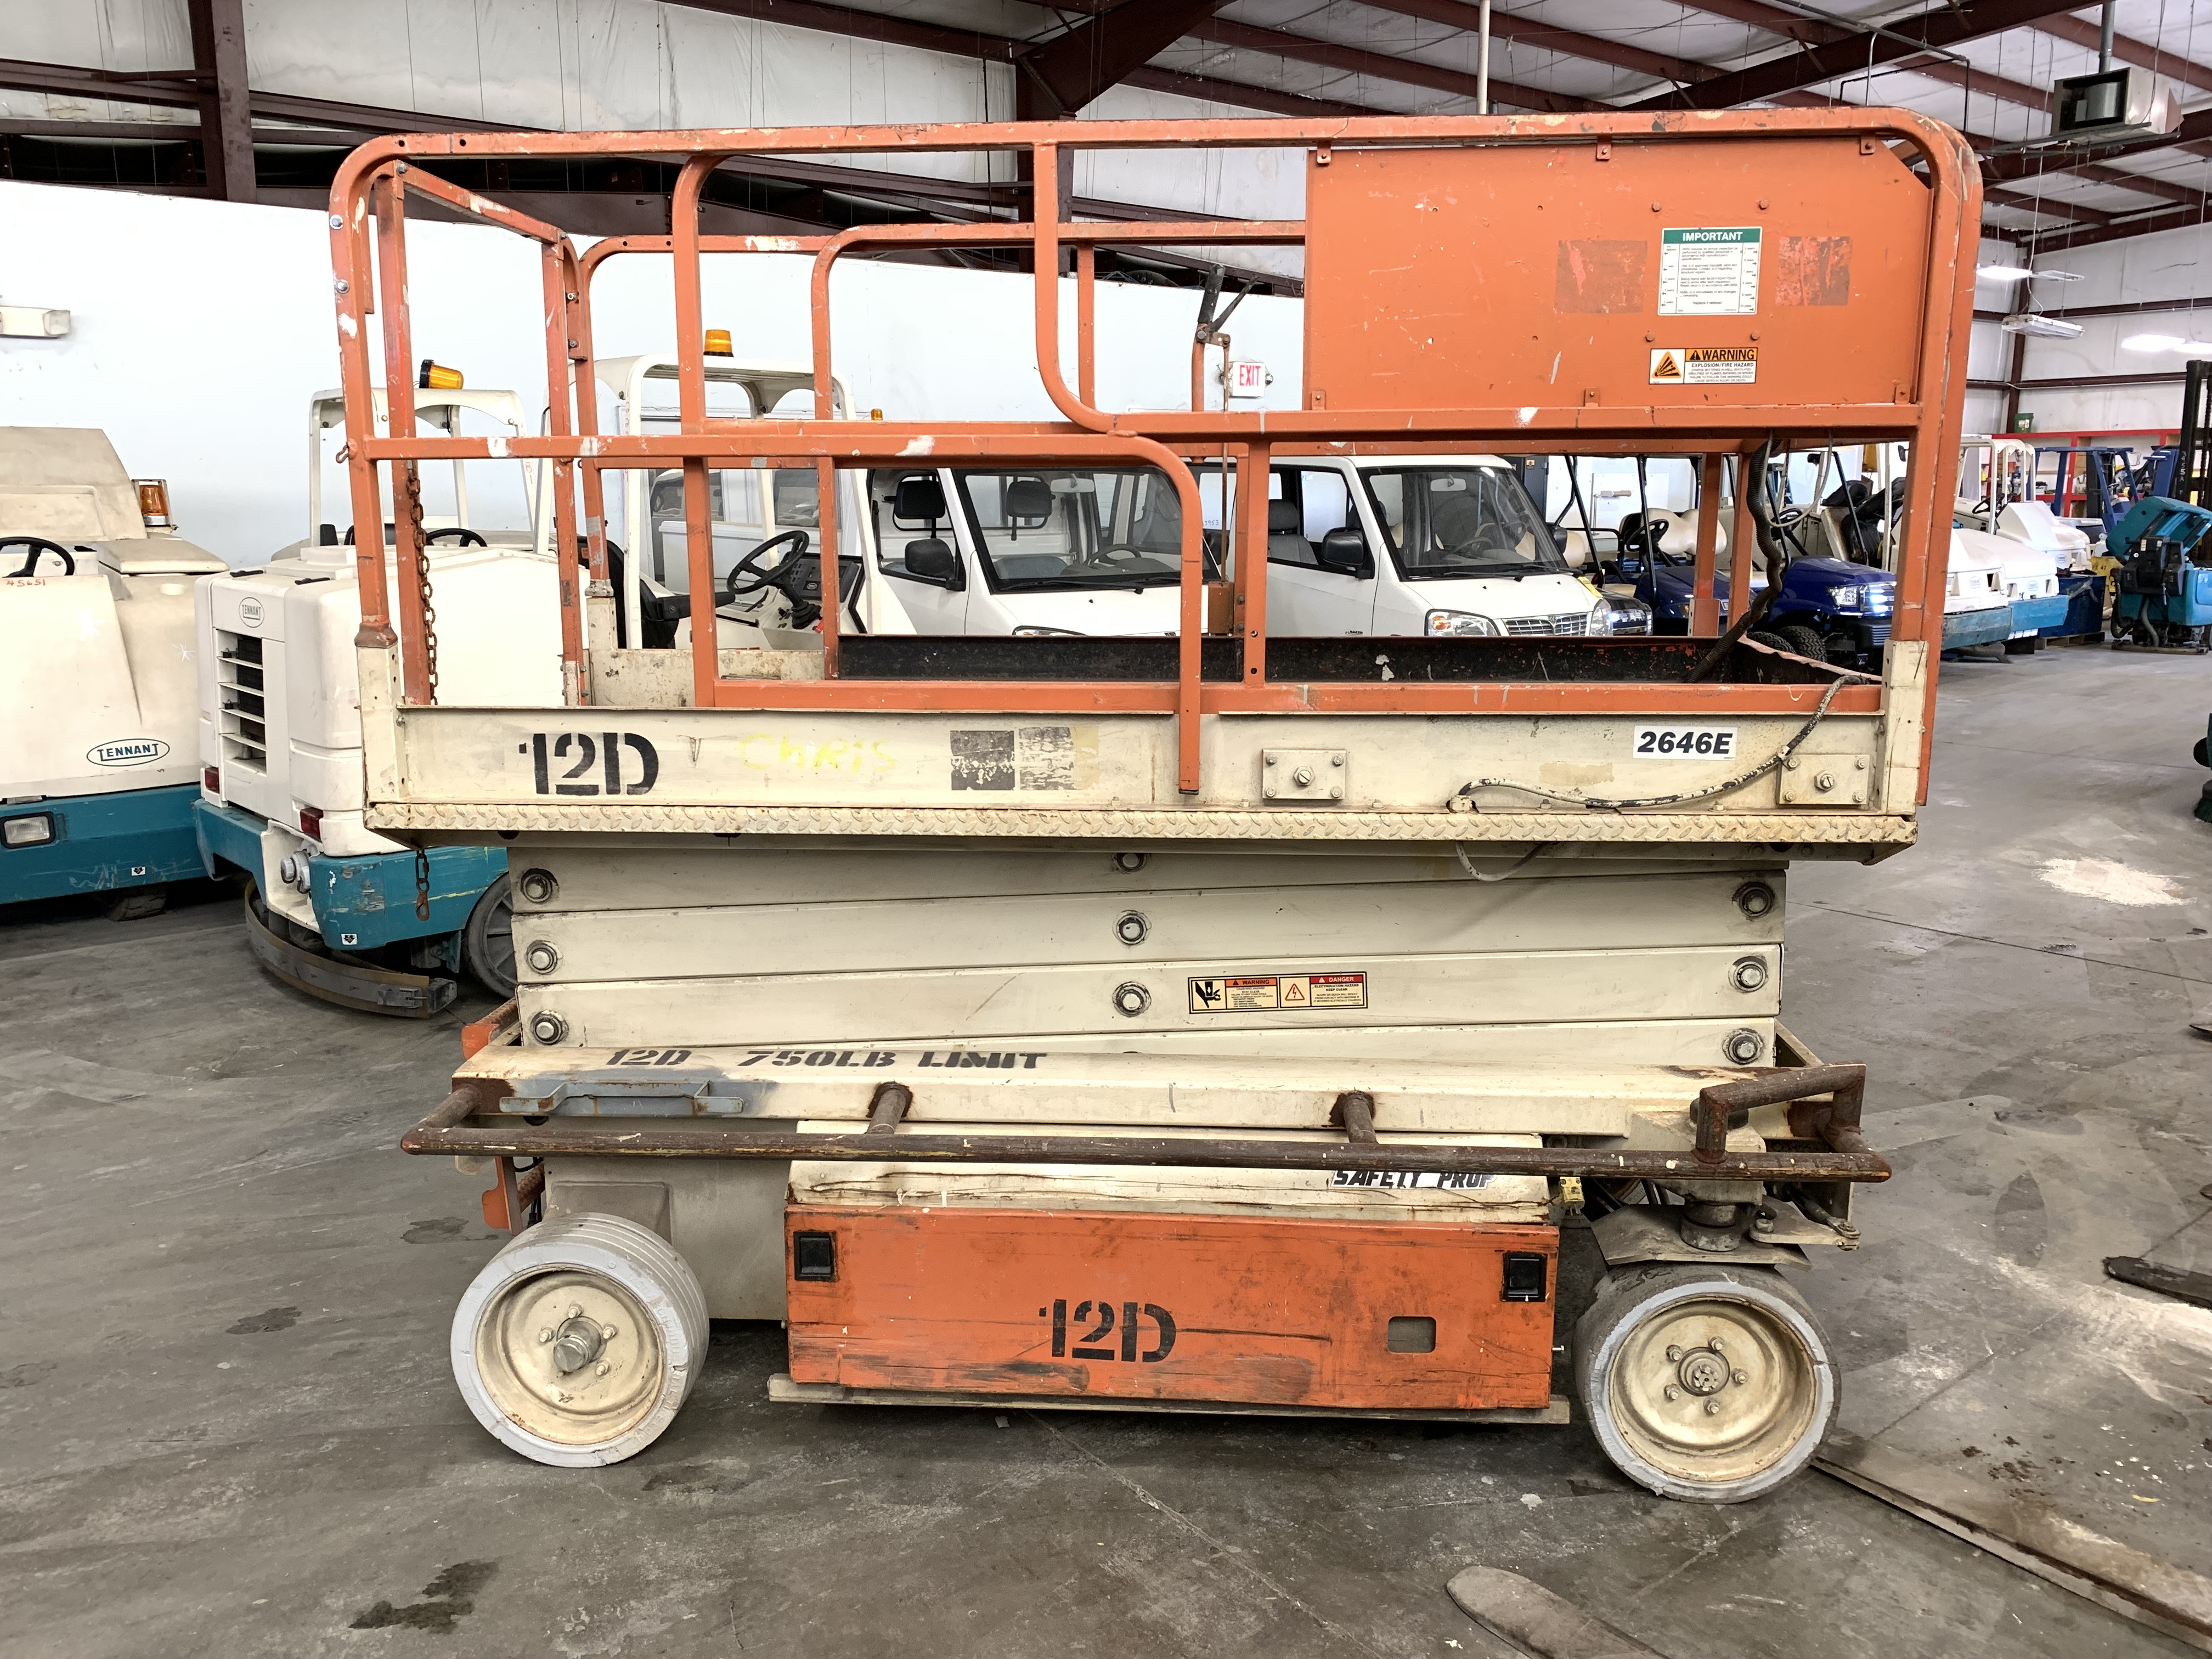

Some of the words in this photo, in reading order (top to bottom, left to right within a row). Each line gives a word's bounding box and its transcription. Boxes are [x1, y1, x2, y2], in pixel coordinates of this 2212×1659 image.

[1683, 232, 1743, 241] IMPORTANT
[1702, 349, 1754, 360] WARNING
[1239, 365, 1261, 386] EXIT
[6, 579, 46, 587] 45651
[242, 604, 261, 620] TENNANT
[1637, 731, 1734, 754] 2646E
[97, 743, 159, 761] TENNANT
[519, 732, 659, 795] 12D
[606, 1049, 692, 1065] 12D
[737, 1051, 896, 1067] 750LB
[918, 1052, 1047, 1069] LIMIT
[1333, 1170, 1421, 1187] SAFETY
[1039, 1299, 1176, 1363] 12D
